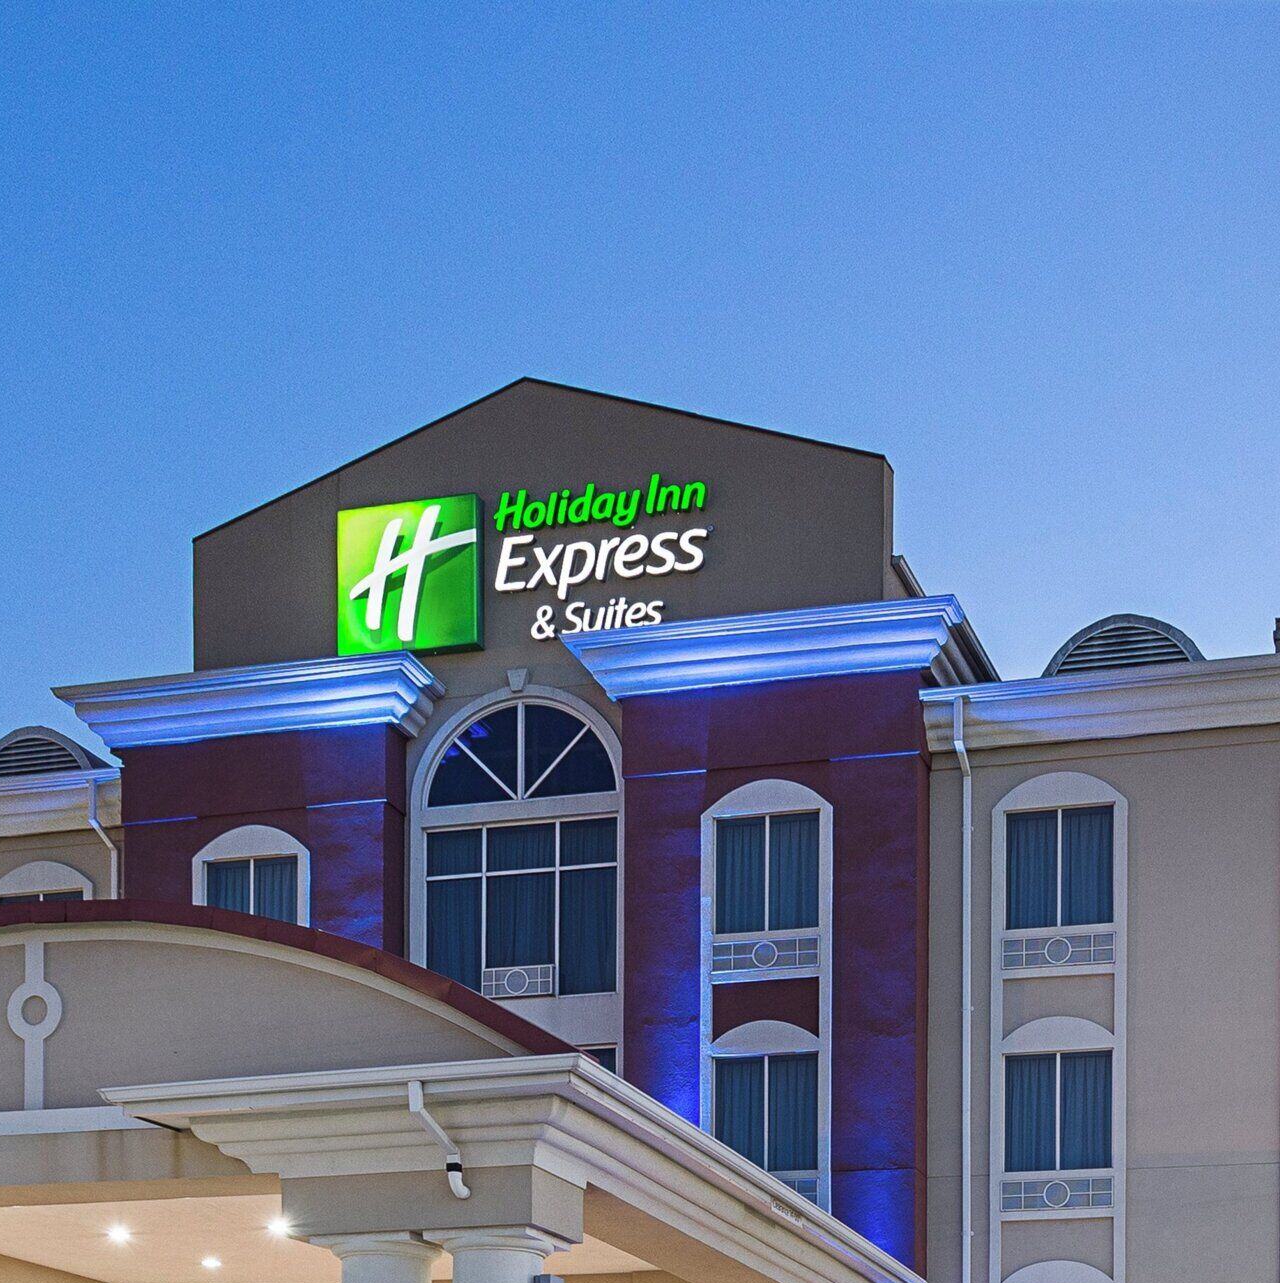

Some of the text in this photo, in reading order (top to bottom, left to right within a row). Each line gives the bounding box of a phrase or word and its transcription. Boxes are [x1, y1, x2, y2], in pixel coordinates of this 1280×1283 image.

[493, 473, 706, 532] Holiday Inn
[494, 528, 708, 600] Express
[530, 596, 664, 640] & Suites
